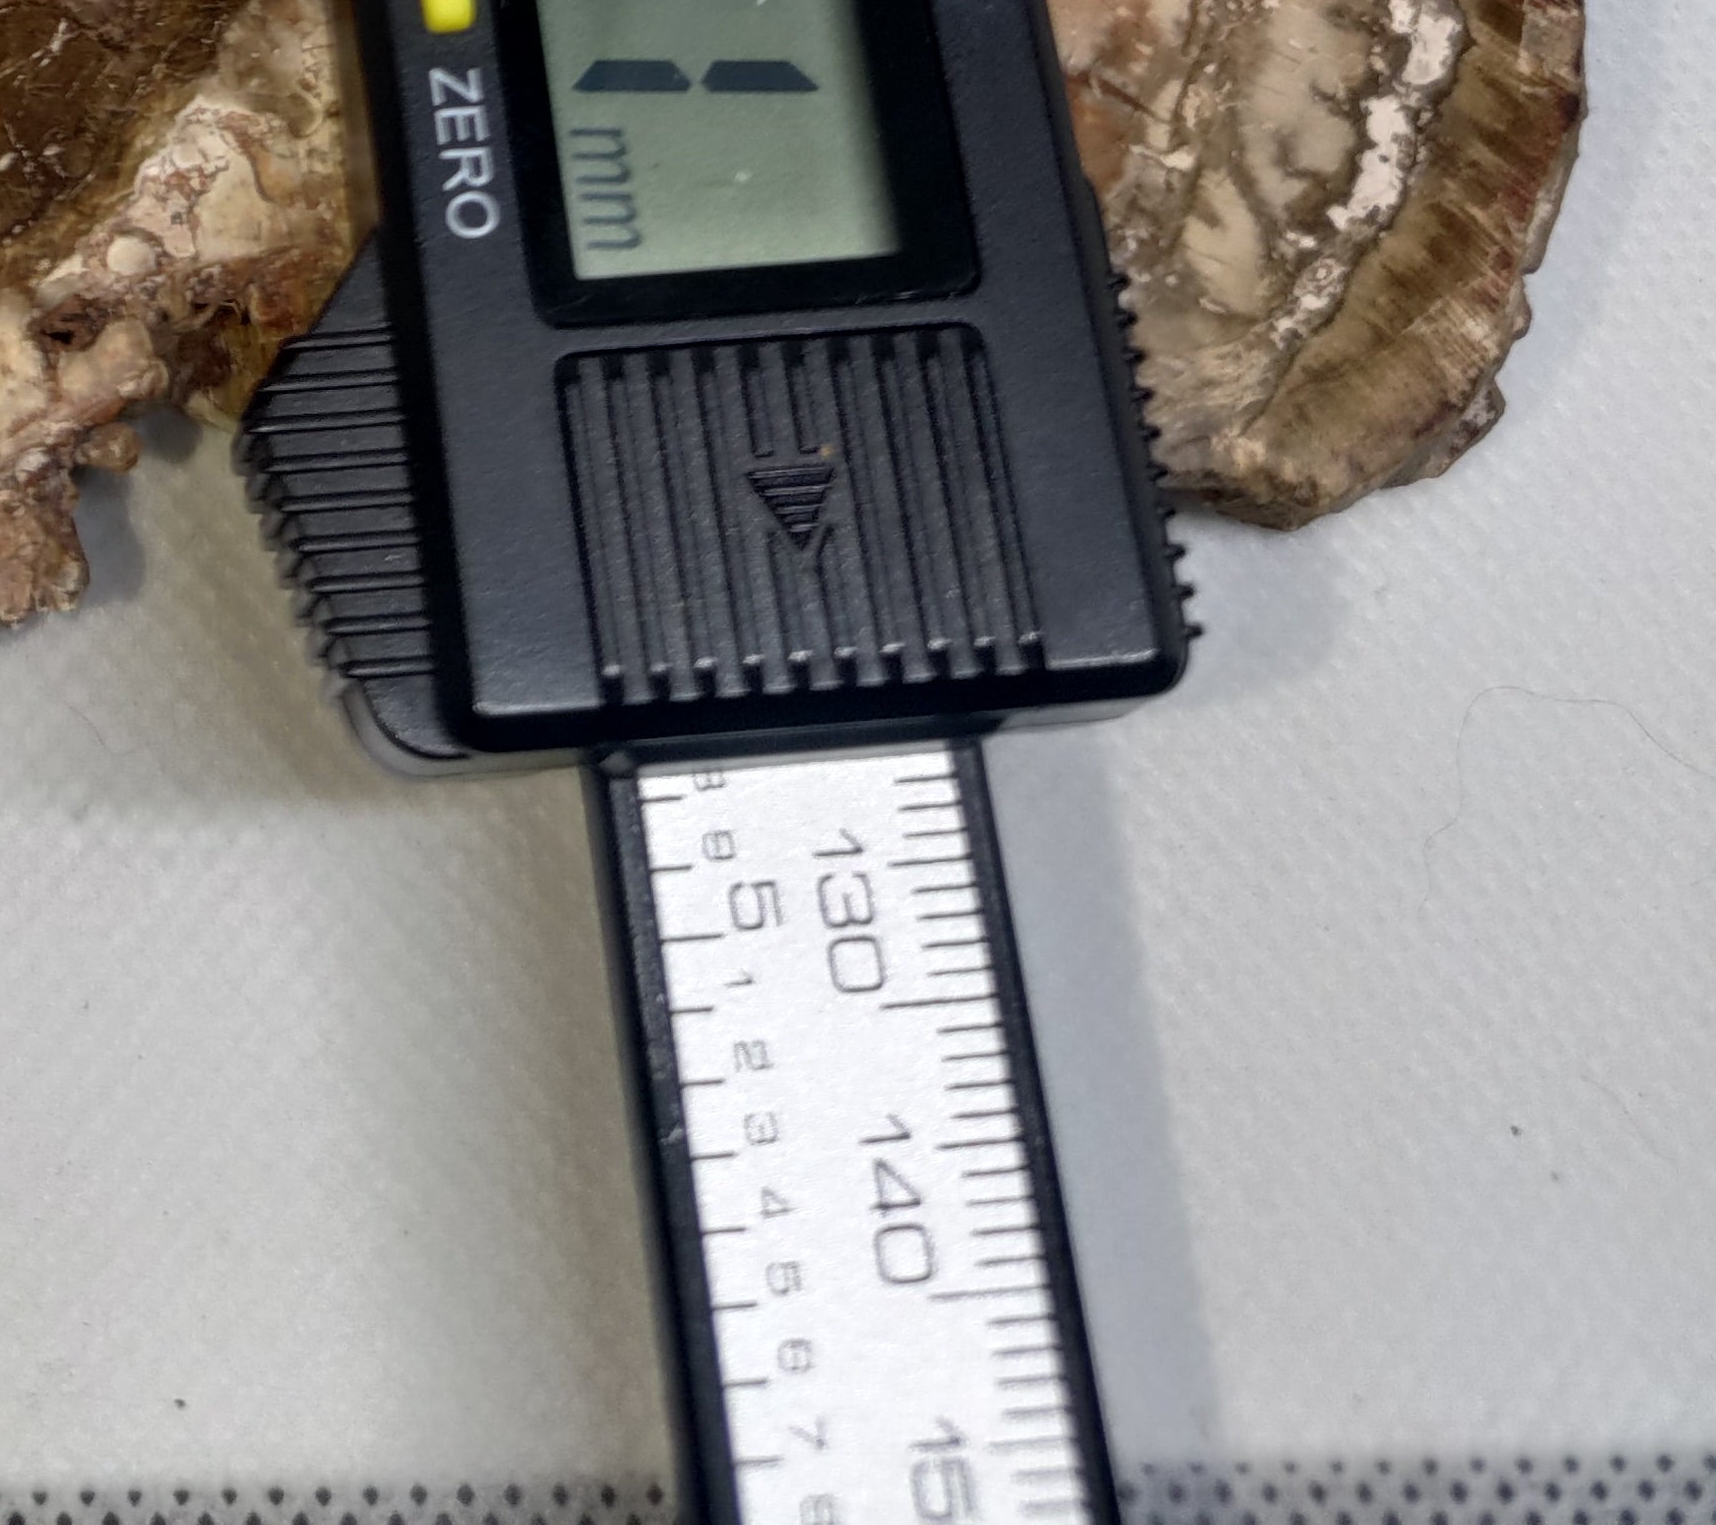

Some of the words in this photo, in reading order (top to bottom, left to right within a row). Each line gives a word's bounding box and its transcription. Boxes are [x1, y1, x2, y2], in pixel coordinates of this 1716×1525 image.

[428, 66, 500, 240] ZERO
[568, 125, 643, 253] mm
[727, 879, 784, 930] 5
[723, 968, 755, 987] 1
[733, 1039, 774, 1072] 2
[811, 826, 886, 994] 130
[858, 1114, 936, 1284] 140
[908, 1415, 976, 1519] 15
[759, 1186, 796, 1219] 4
[788, 1415, 829, 1449] 7
